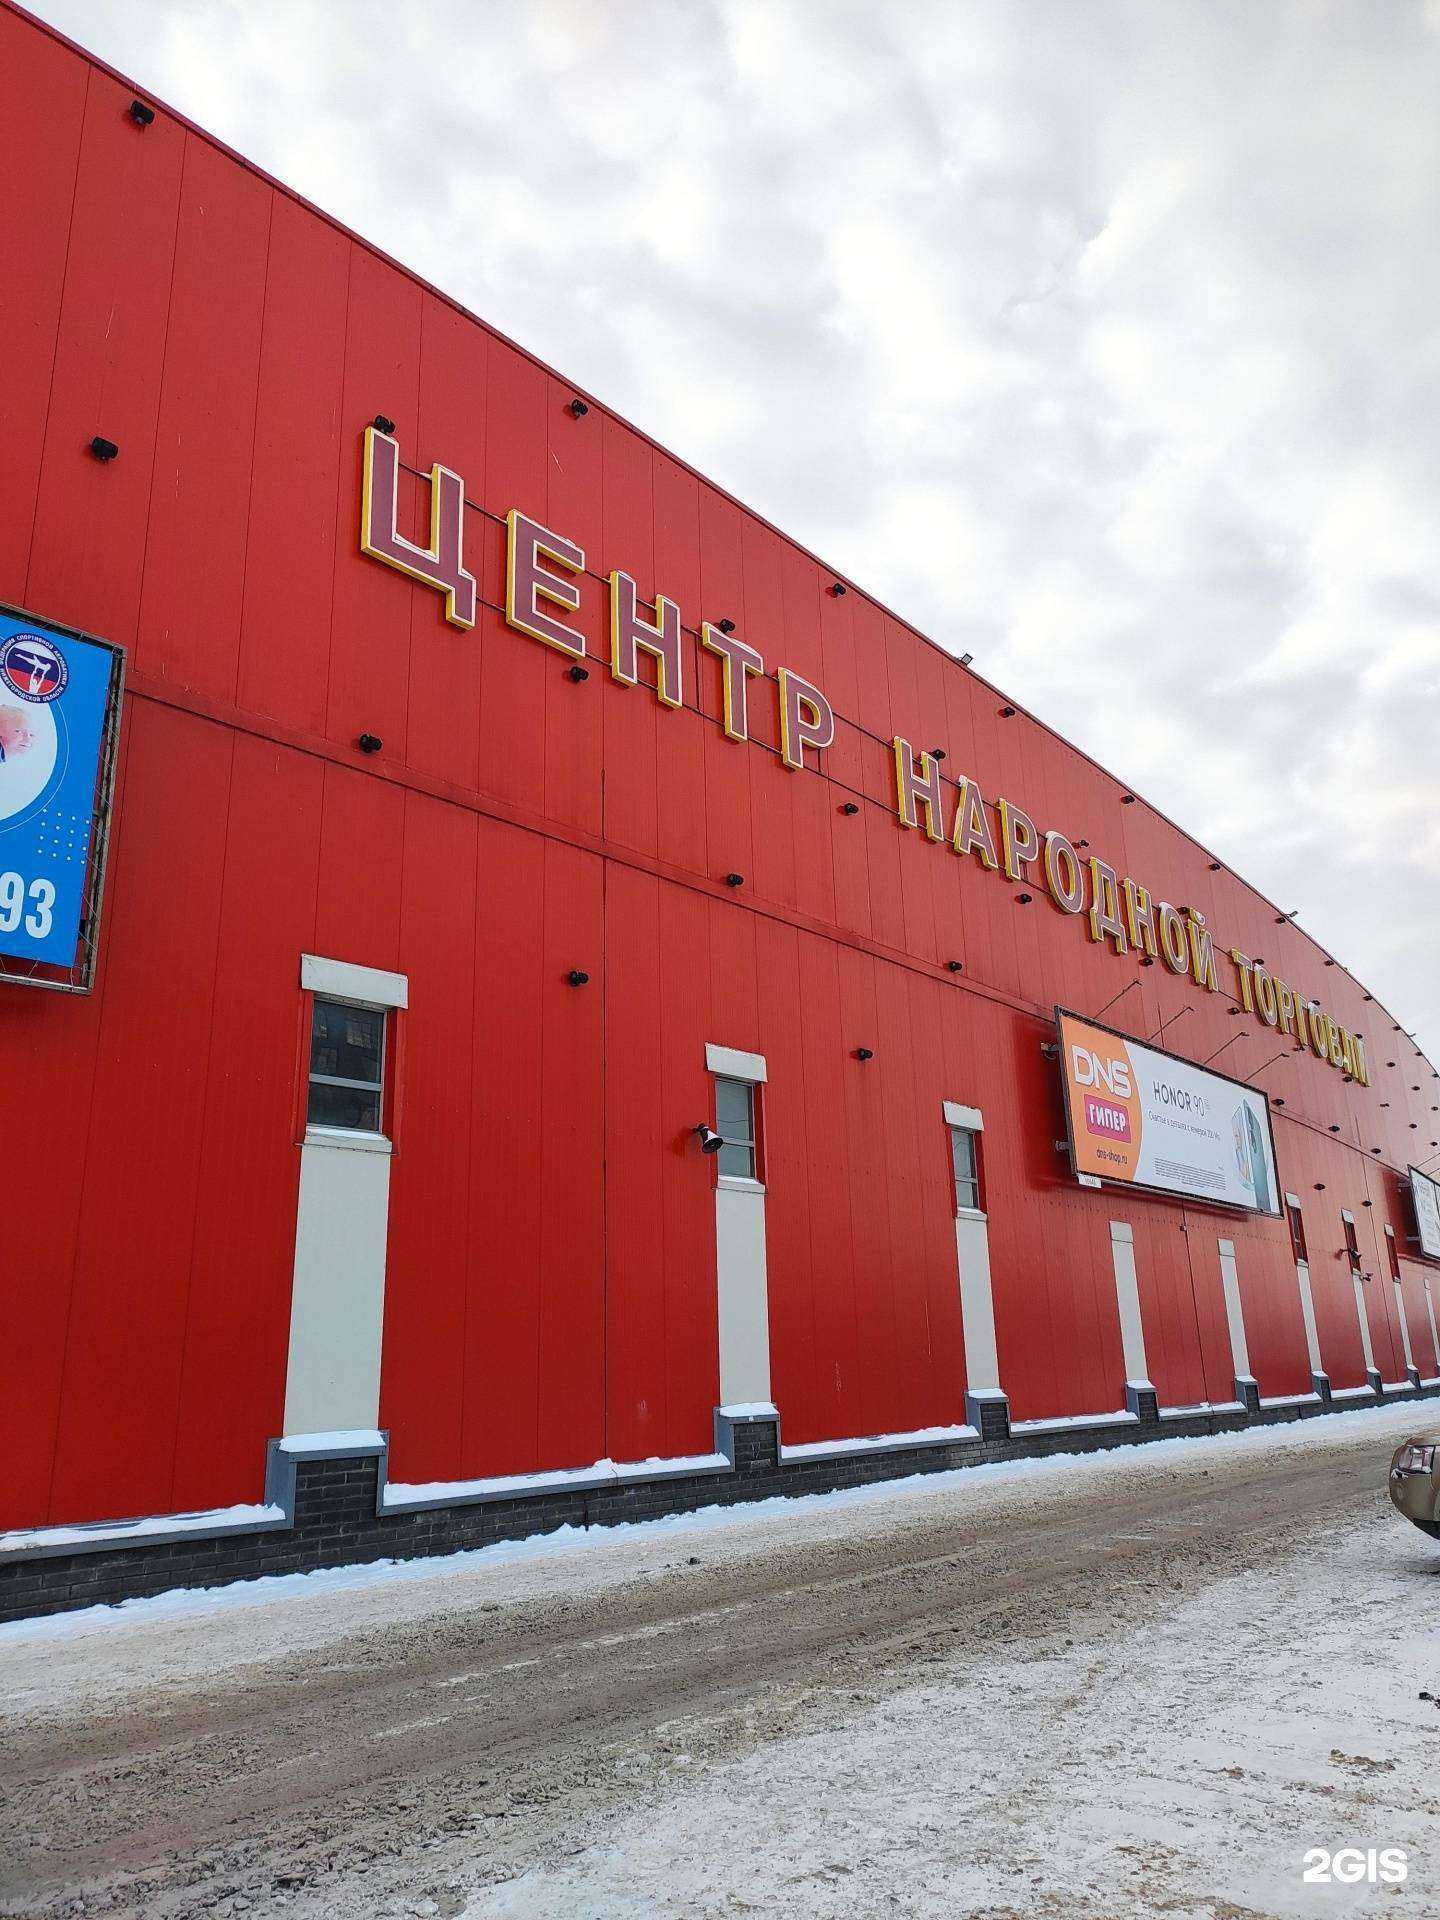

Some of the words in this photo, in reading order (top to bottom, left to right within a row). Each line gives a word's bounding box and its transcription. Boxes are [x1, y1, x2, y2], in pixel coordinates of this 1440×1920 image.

[361, 426, 835, 771] ЦЕНТР
[894, 736, 1220, 992] НАРОДНОЙ
[1230, 948, 1371, 1087] ТОРГОВЛИ
[0, 871, 56, 938] 93
[1071, 1044, 1132, 1098] DNS
[1089, 1103, 1126, 1132] ГИПЕР
[1153, 1080, 1192, 1113] HONOR
[1192, 1095, 1205, 1117] 90
[1096, 1147, 1128, 1166] dns-shop.ru
